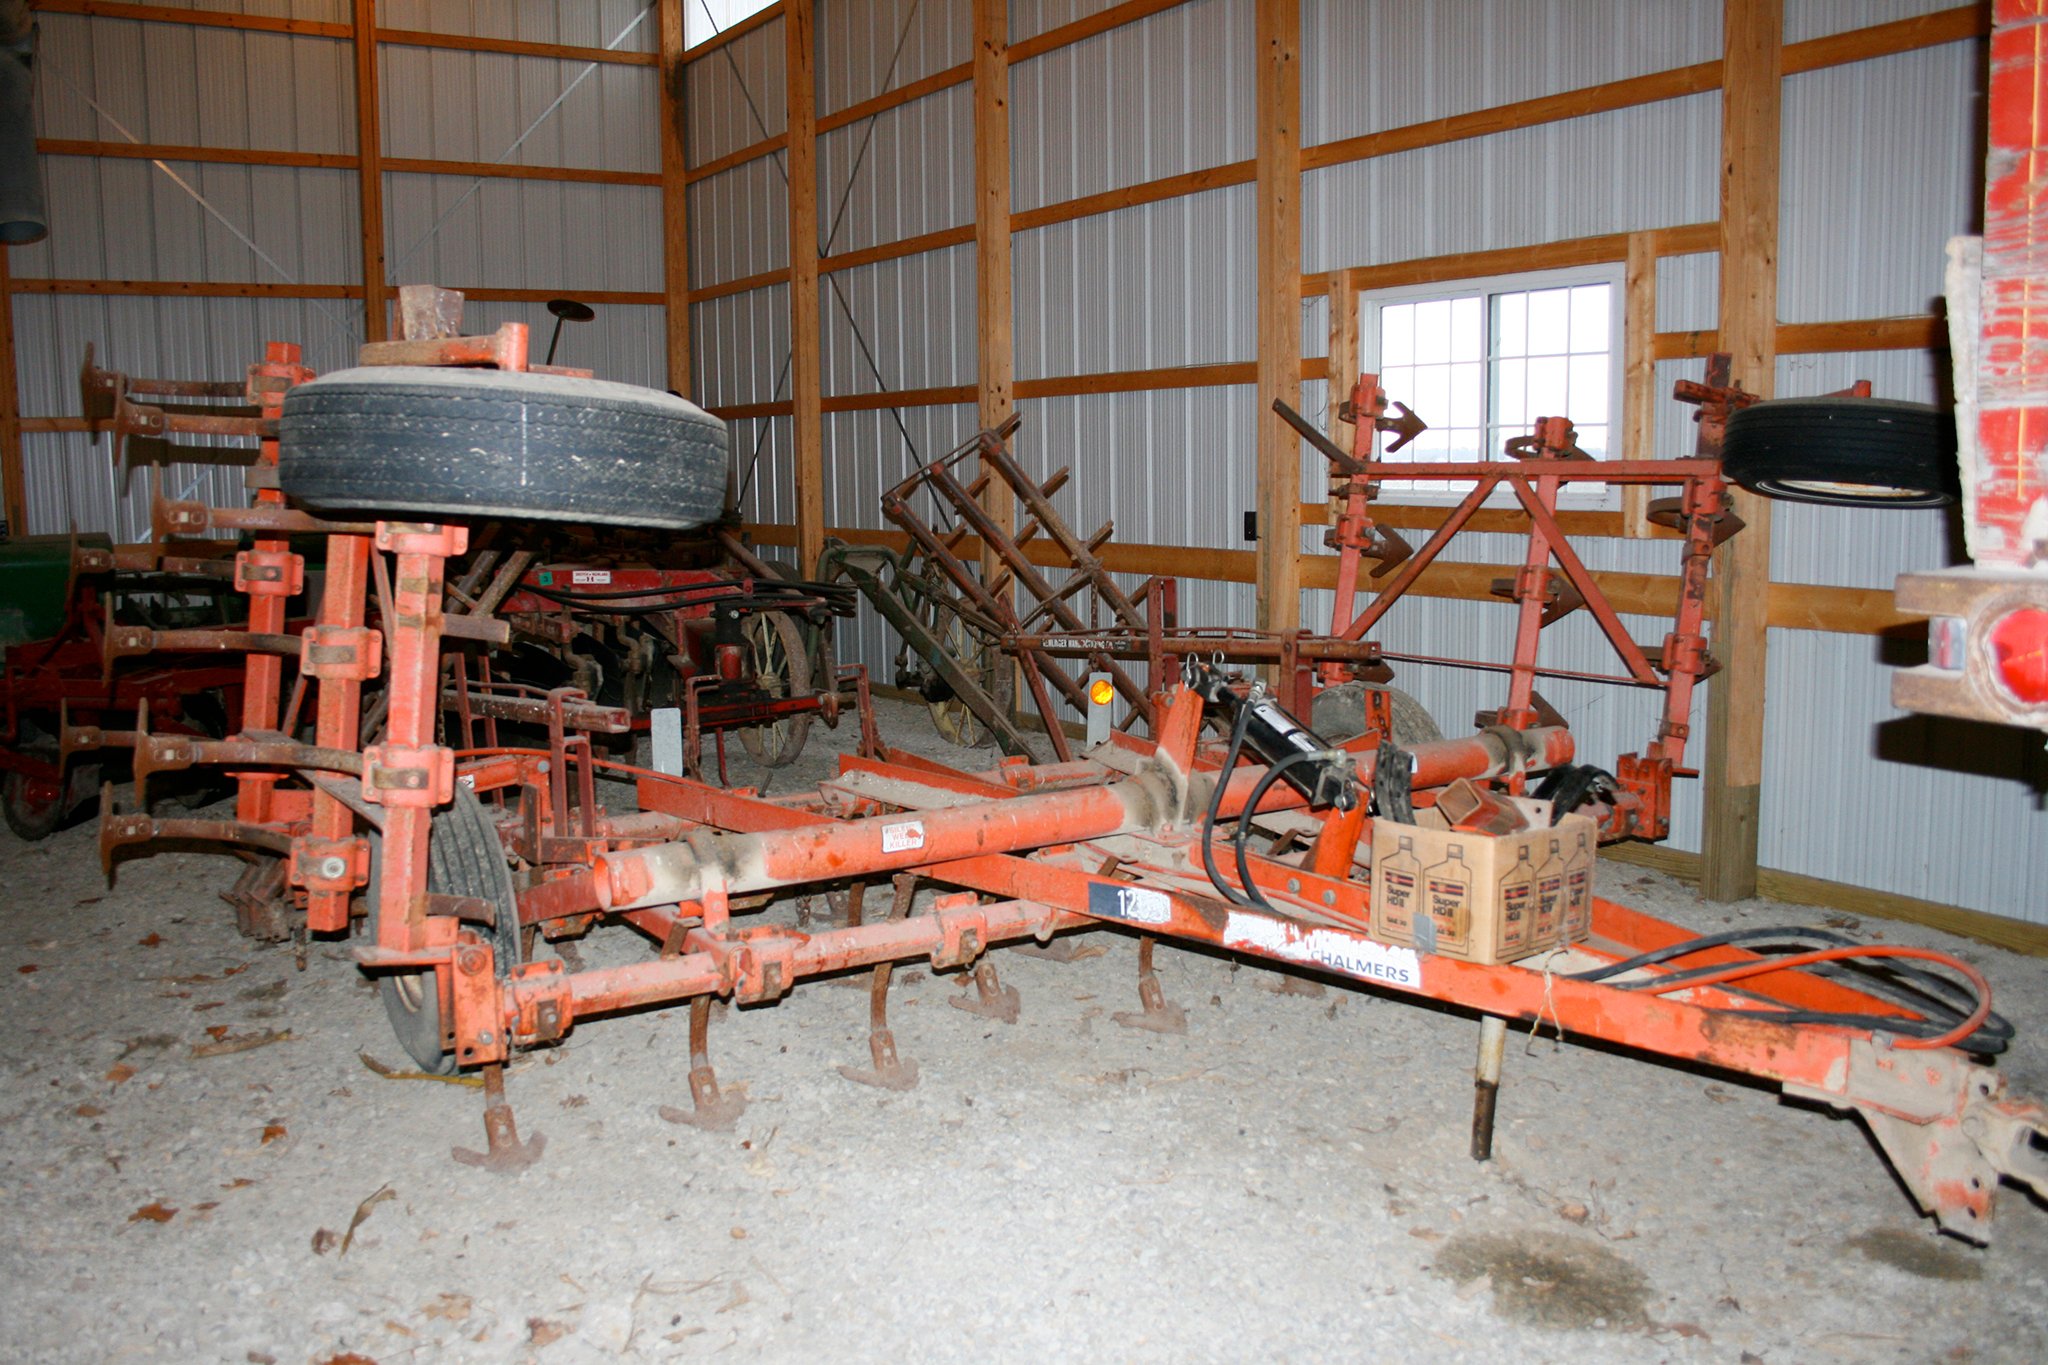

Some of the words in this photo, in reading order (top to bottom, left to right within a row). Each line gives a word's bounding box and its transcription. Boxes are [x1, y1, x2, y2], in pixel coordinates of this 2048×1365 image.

[890, 838, 917, 849] KILLER
[1387, 885, 1410, 898] Super
[1432, 894, 1461, 908] Super
[1506, 901, 1526, 912] Super
[1310, 950, 1409, 983] CHALMERS
